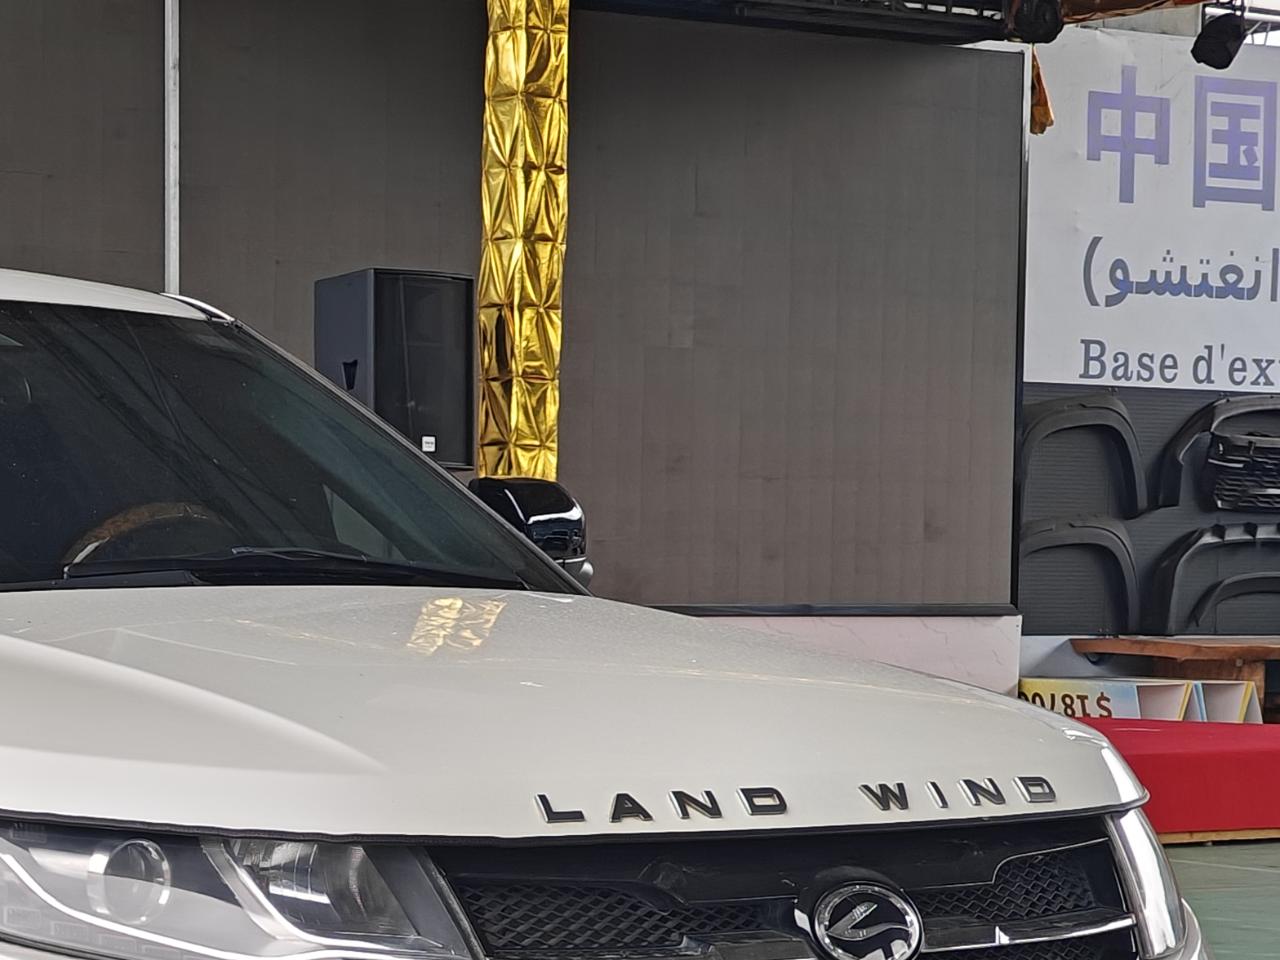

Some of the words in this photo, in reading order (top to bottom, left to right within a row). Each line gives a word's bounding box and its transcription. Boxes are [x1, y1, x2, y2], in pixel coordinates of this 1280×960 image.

[1087, 65, 1278, 211] 中国
[1078, 338, 1179, 383] Base
[534, 786, 788, 824] LAND
[858, 775, 1057, 812] WIND
